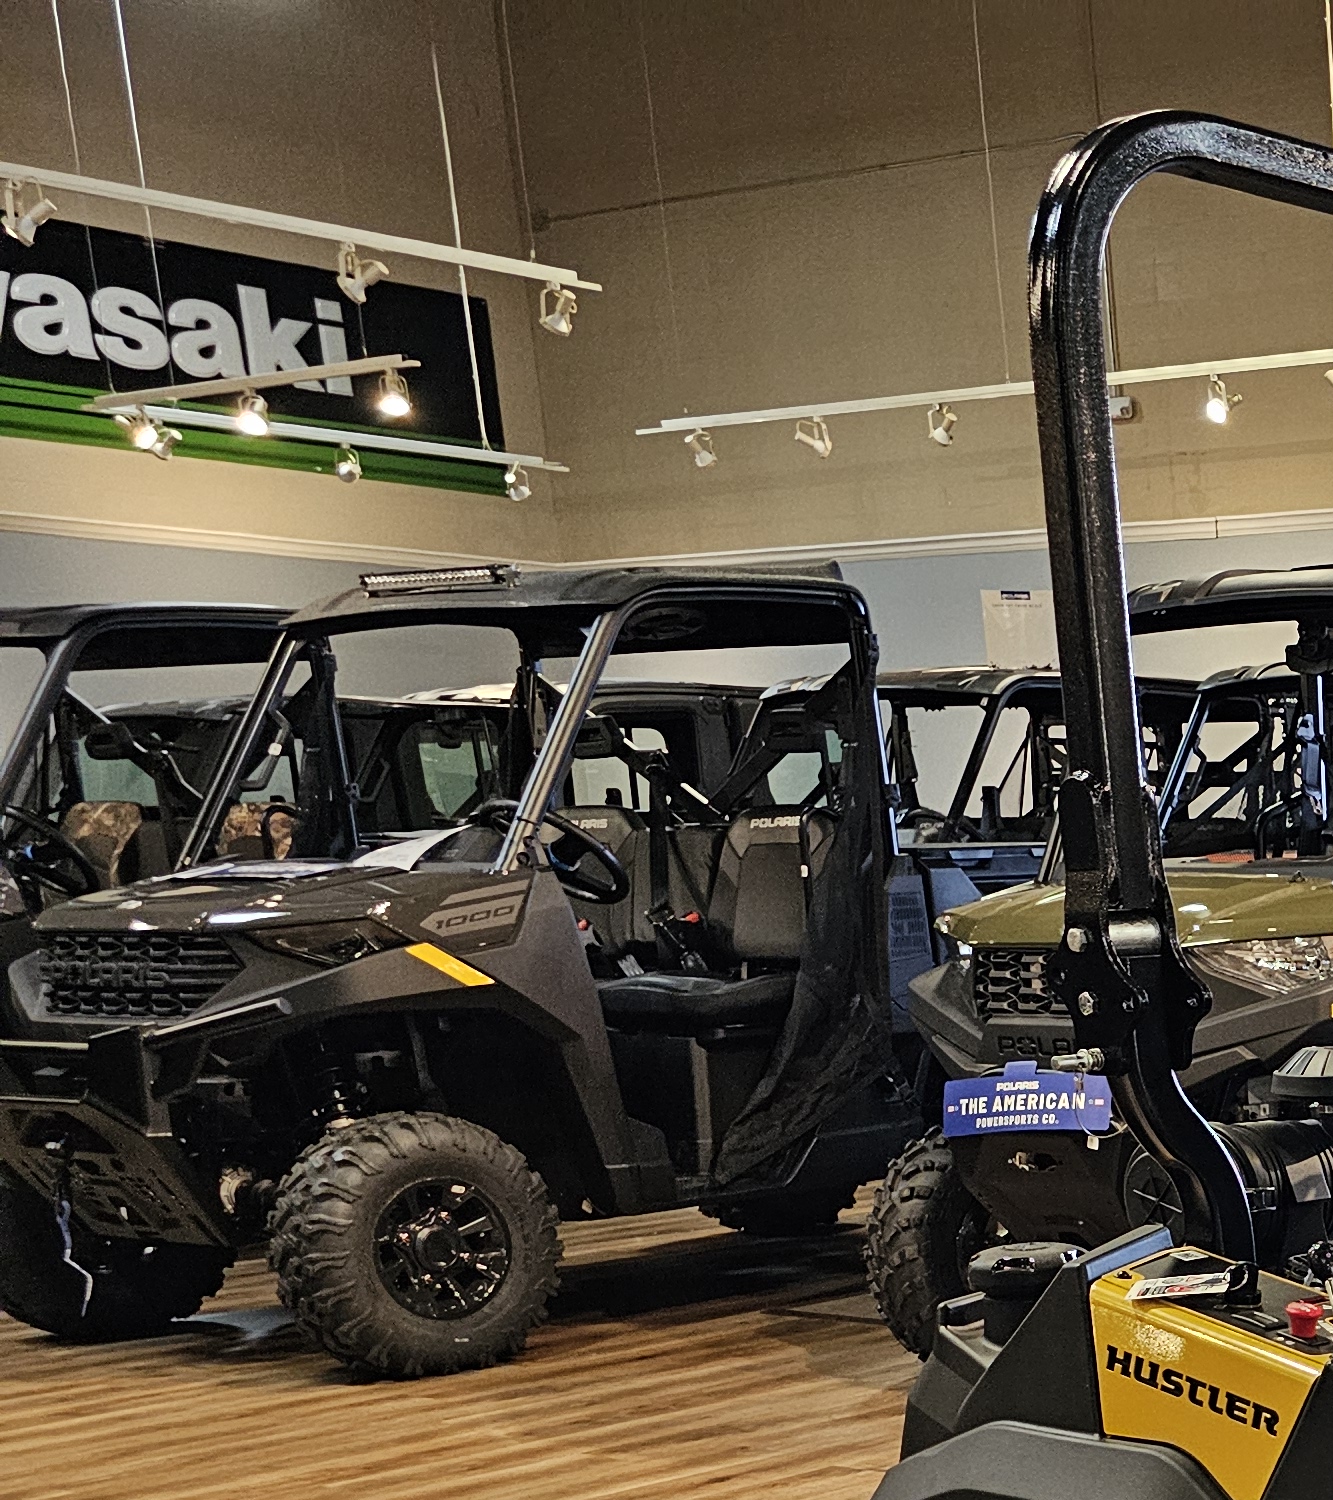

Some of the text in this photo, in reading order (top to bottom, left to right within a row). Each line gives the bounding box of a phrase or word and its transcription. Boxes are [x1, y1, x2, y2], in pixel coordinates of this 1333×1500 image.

[0, 270, 354, 397] asaki
[436, 904, 515, 930] 1000
[959, 1092, 1086, 1116] THE AMERICAN
[975, 1113, 1040, 1129] POWERSPORTS
[1105, 1344, 1280, 1437] HUSTLER
